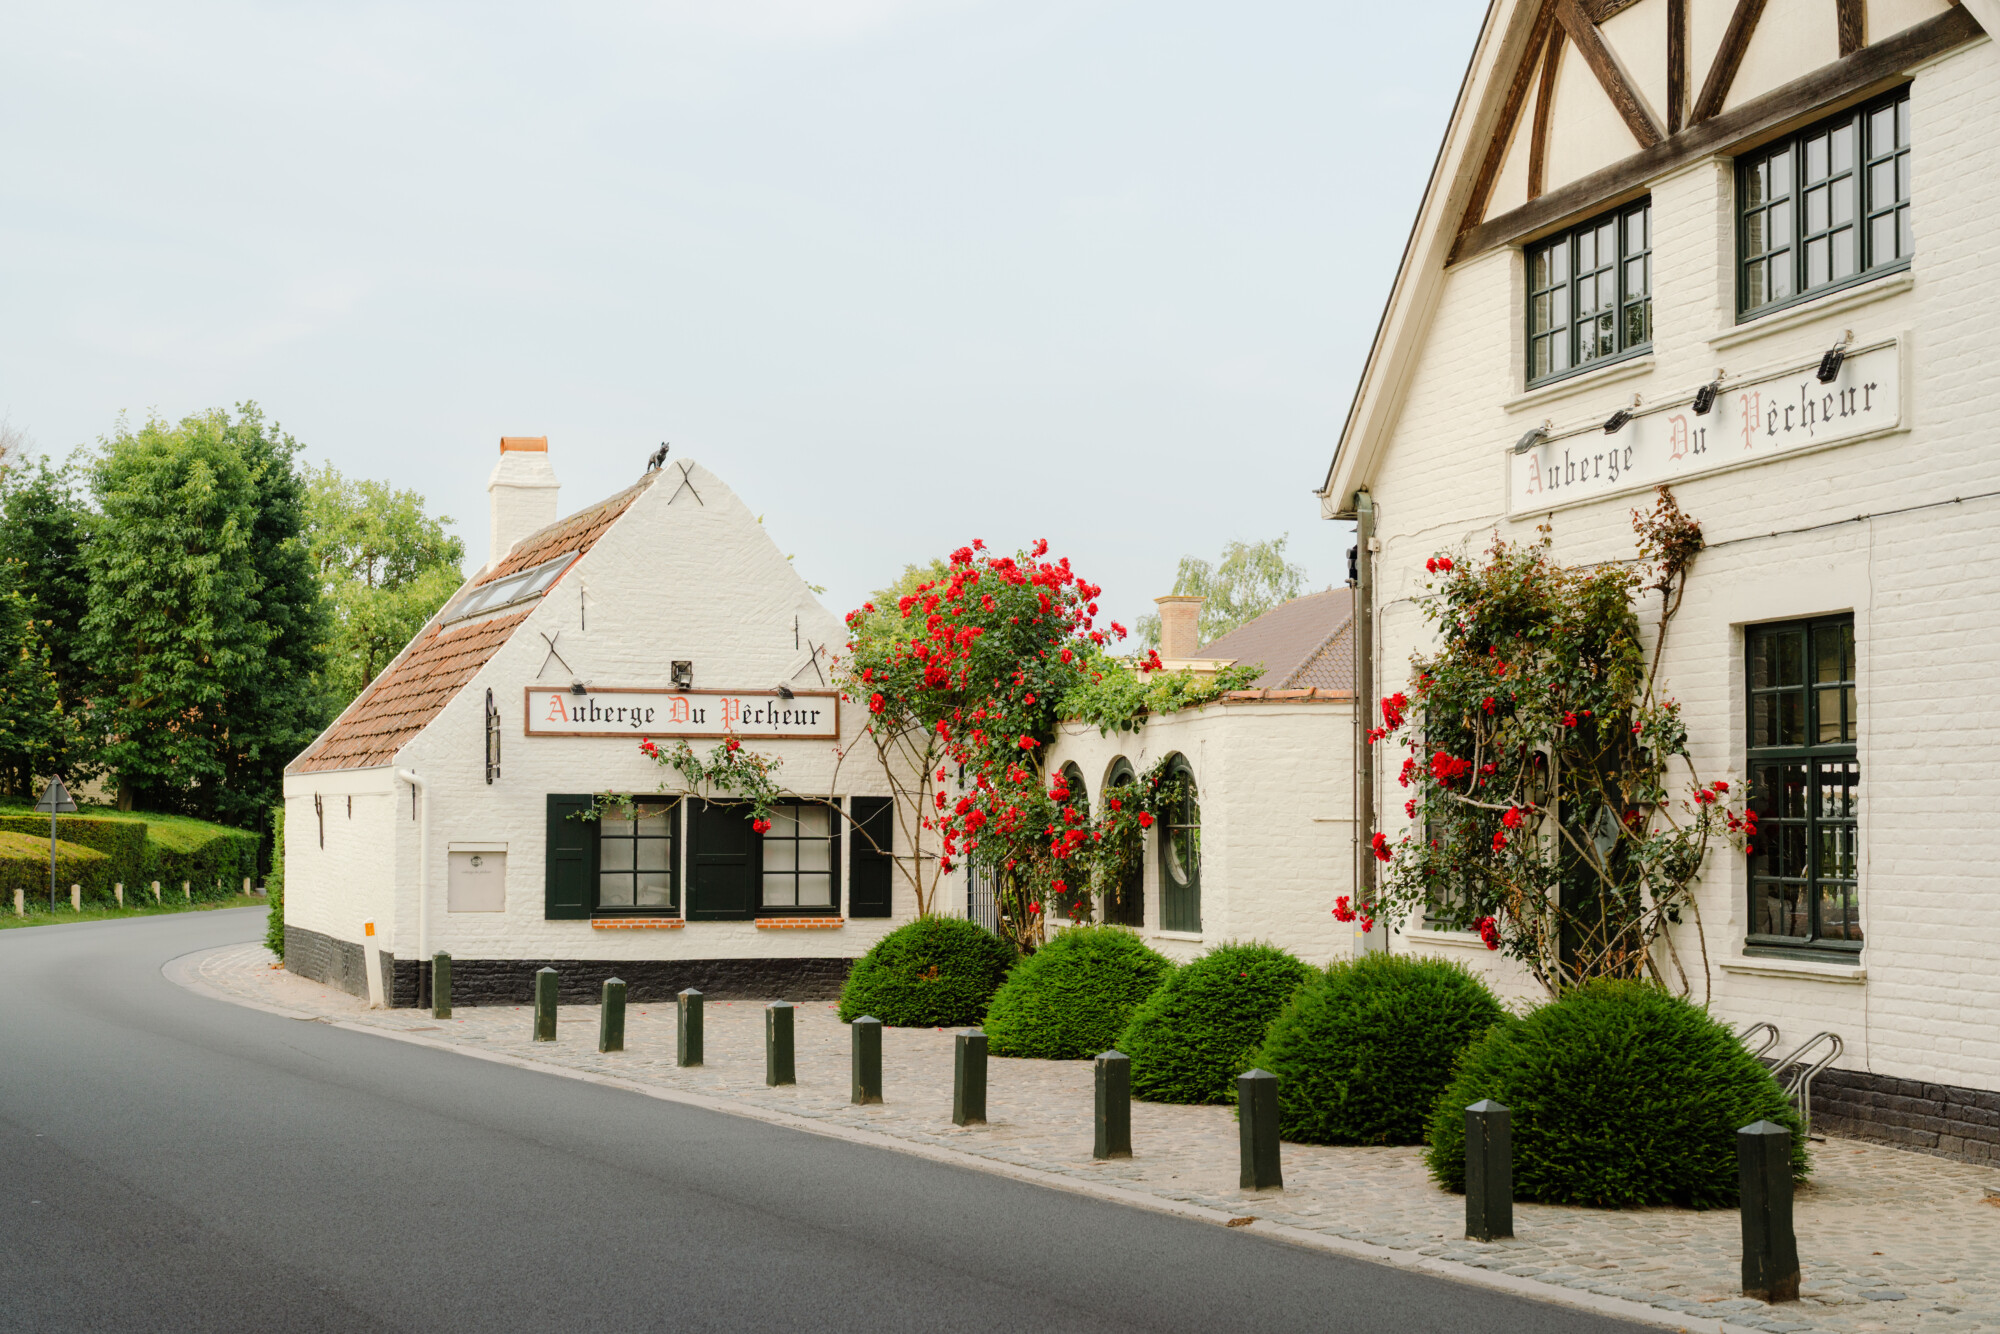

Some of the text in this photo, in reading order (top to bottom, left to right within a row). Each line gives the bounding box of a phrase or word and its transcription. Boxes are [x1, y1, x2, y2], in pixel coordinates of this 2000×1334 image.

[1525, 379, 1878, 495] Auberge Du Pêcheur
[545, 694, 821, 730] Auberge Du Pêcheur
